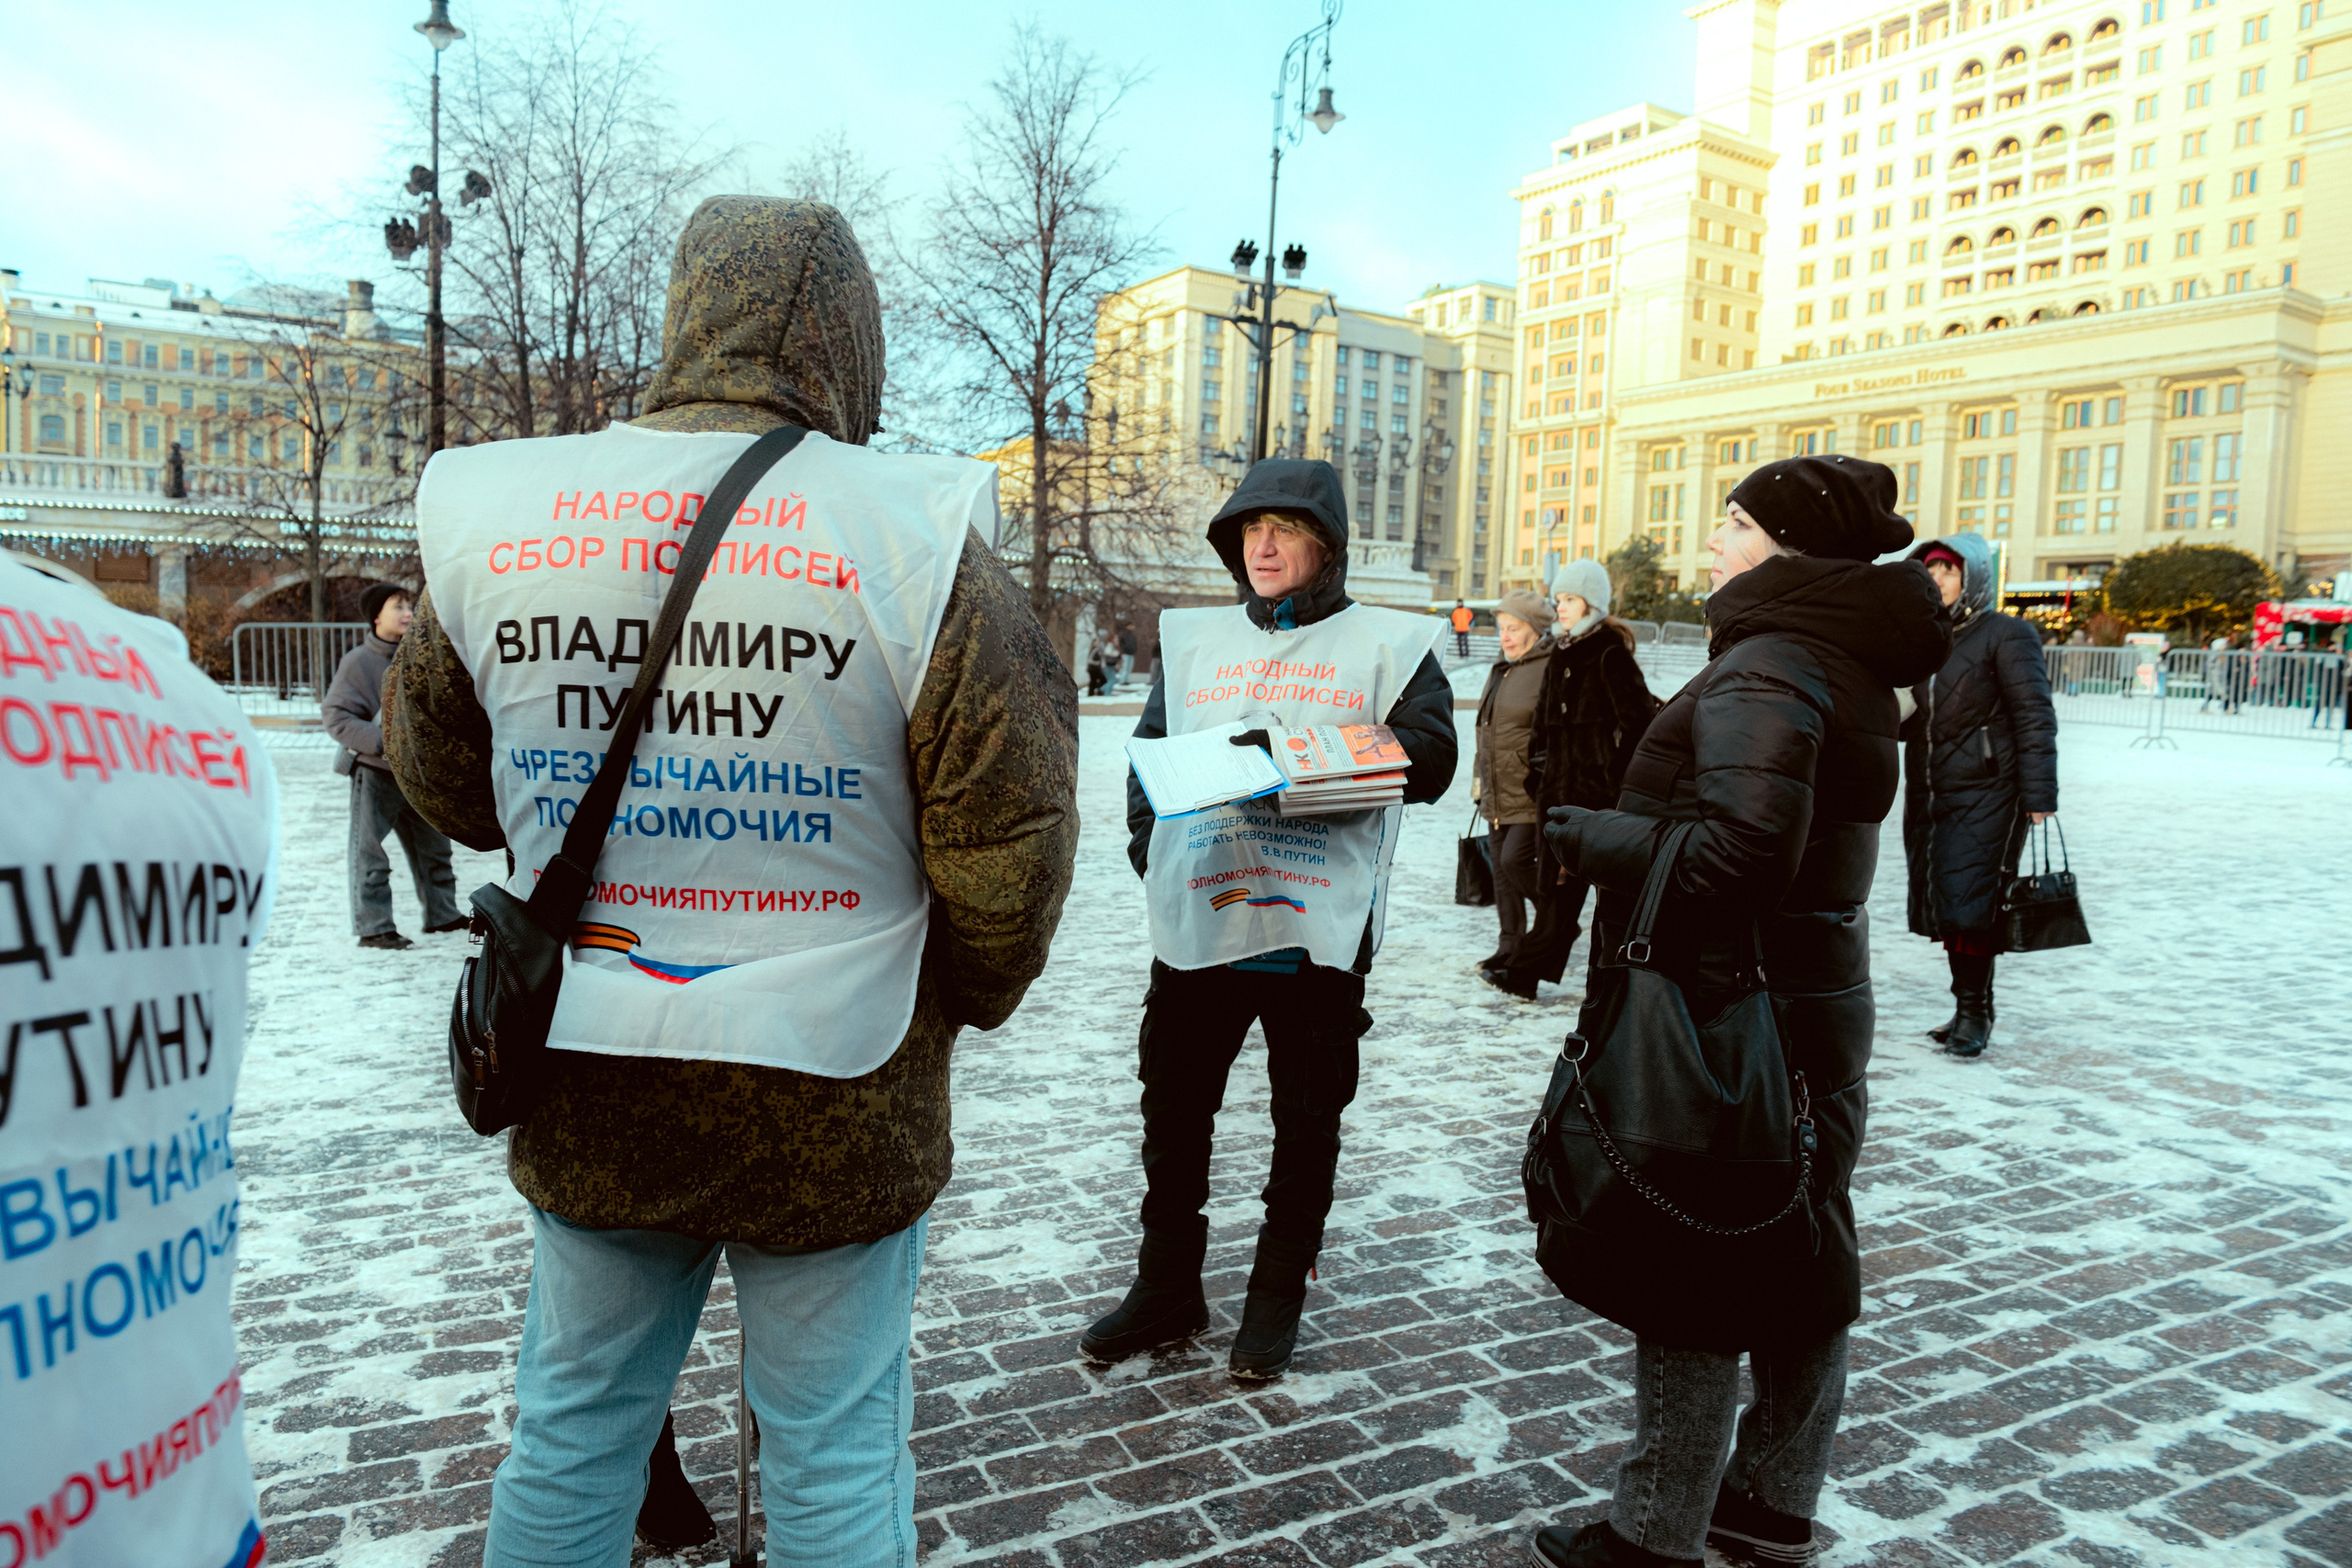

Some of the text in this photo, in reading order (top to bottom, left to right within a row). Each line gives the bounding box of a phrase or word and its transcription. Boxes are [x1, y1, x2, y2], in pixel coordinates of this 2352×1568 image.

[1853, 374, 1913, 393] SEASONS
[1917, 367, 1967, 385] HOTEL
[552, 490, 808, 531] НАРОДЫЙ
[488, 535, 861, 595] СБОР ПОПИСЕЙ
[495, 615, 857, 682] ВЛАДМИРУ
[1185, 685, 1240, 708] СБОР
[511, 748, 863, 800] ЧРЕЗЫЧАЙНЫЕ
[534, 795, 832, 843] ПОНОМОЧИЯ
[1188, 815, 1329, 838] БЕЗ ПОДДЕРЖКИ НАРОДА
[1187, 829, 1327, 852] РАБОТАТЬ НЕВОЗМОЖНО!
